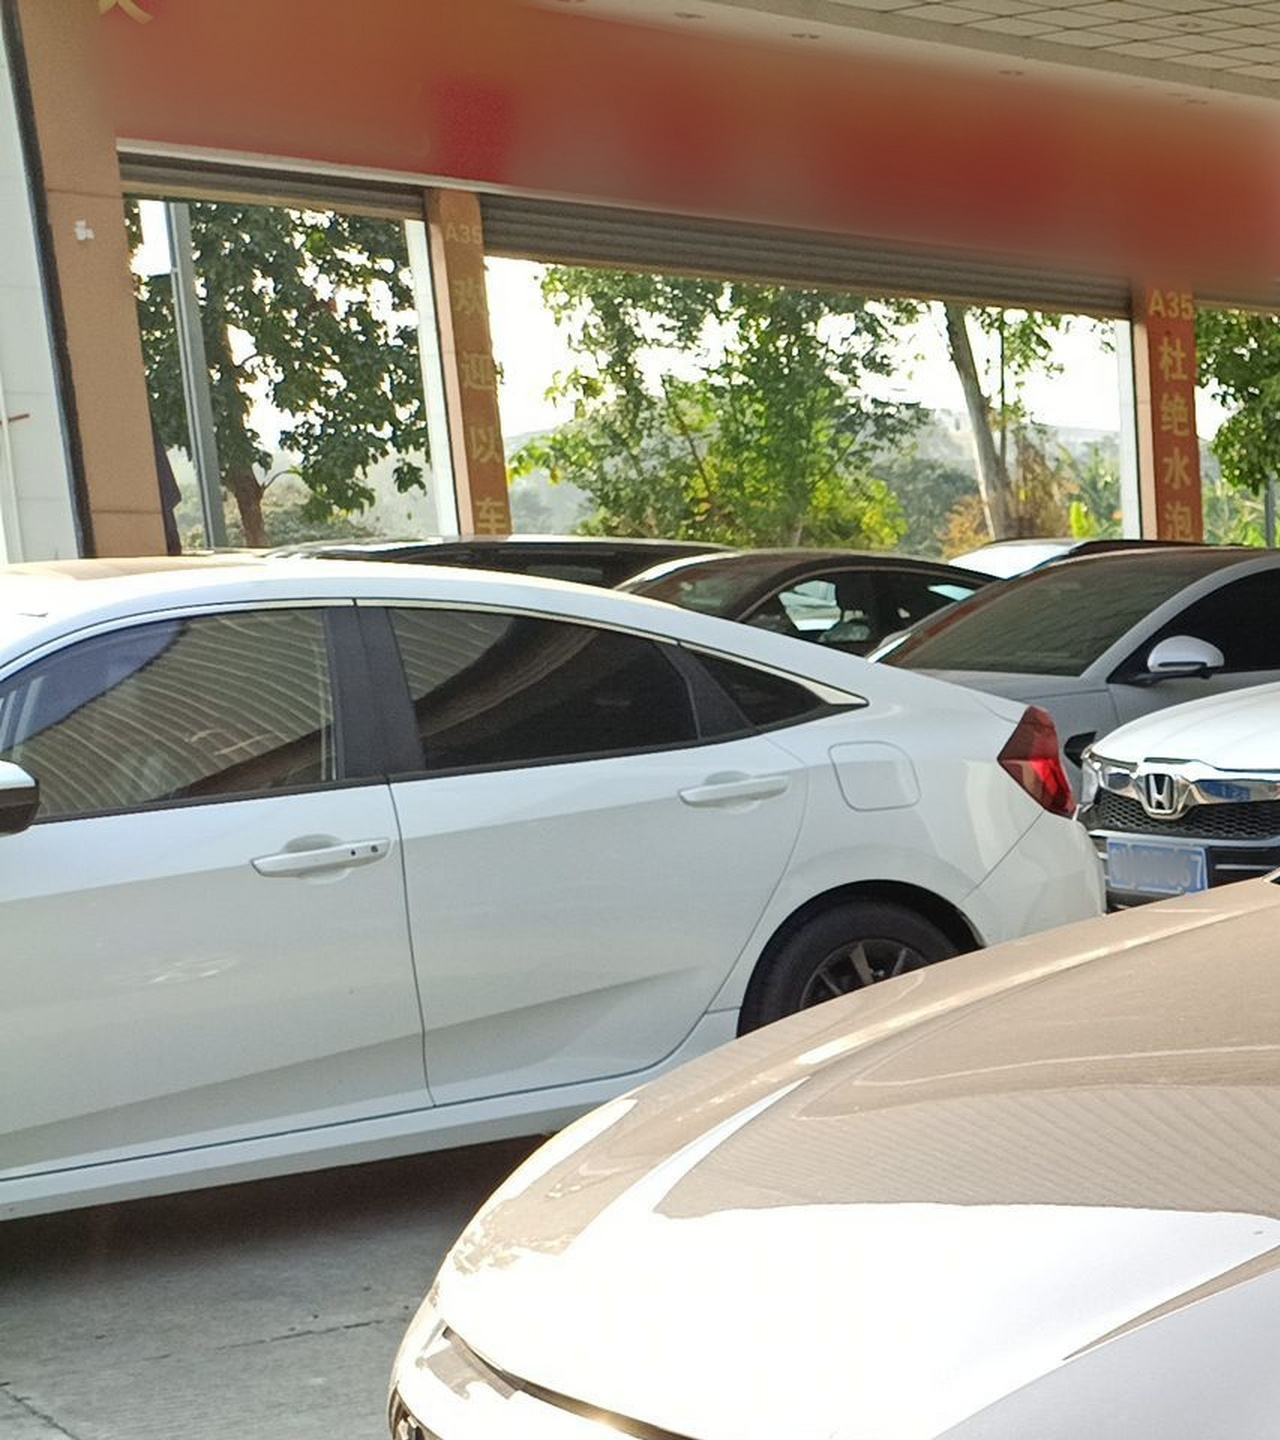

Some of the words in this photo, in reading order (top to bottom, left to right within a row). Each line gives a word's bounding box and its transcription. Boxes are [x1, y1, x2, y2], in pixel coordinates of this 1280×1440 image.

[1149, 289, 1195, 320] A35
[1159, 335, 1194, 541] 杜绝水泡
